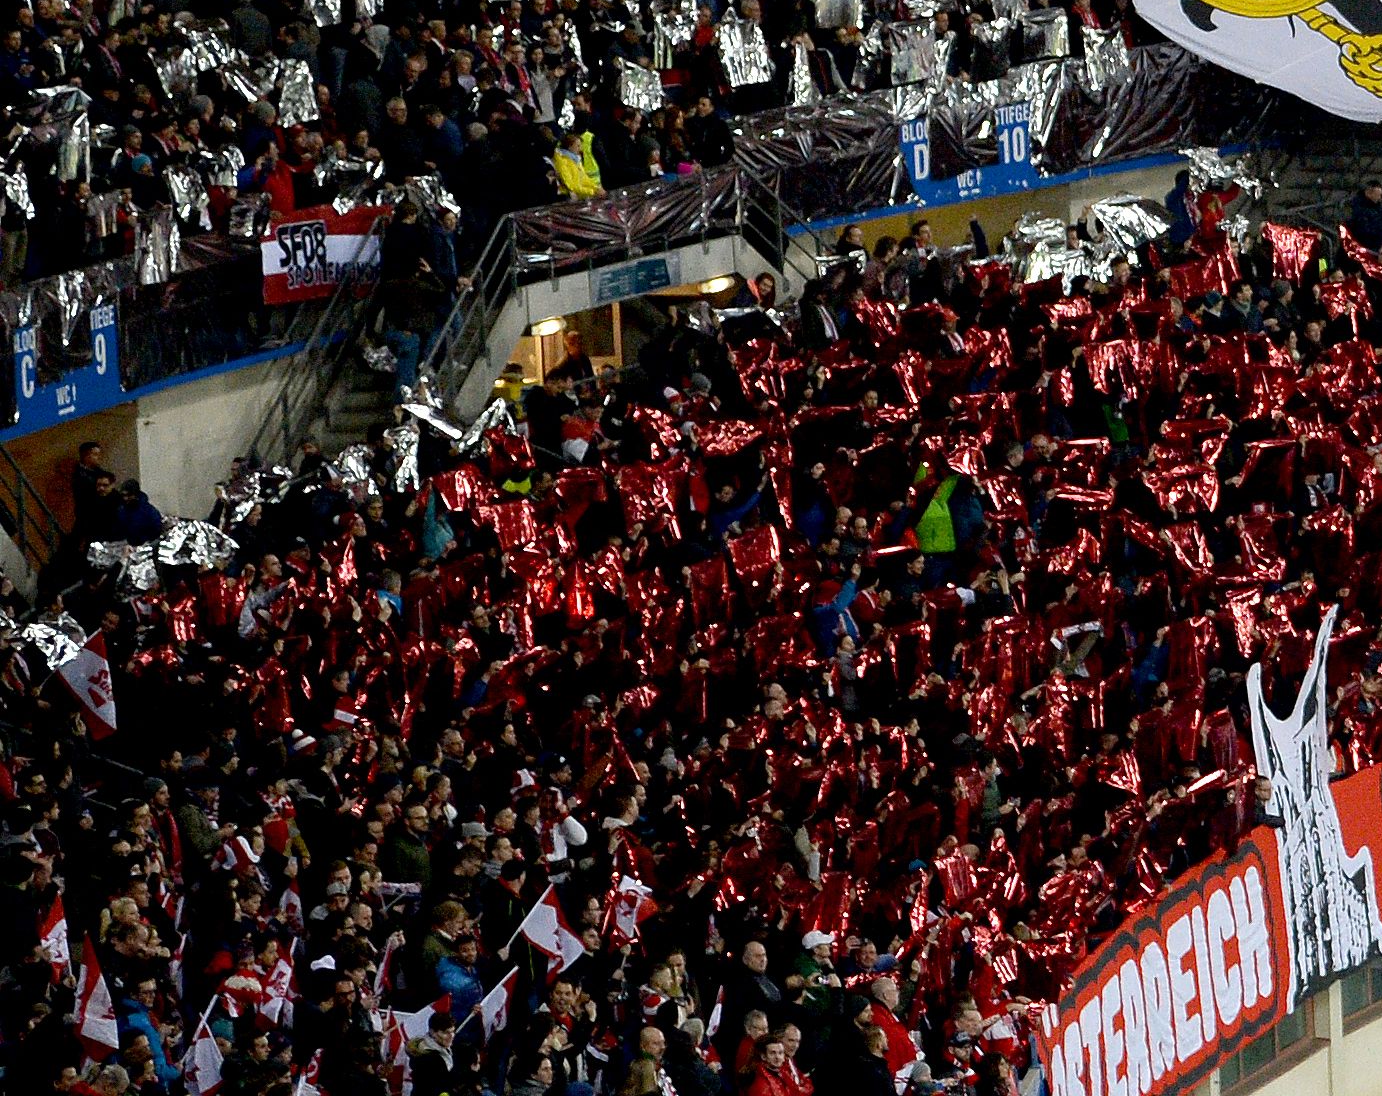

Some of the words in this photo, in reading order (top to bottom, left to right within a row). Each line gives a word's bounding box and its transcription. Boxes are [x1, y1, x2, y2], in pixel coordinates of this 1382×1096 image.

[914, 143, 930, 181] D
[999, 126, 1026, 164] 10
[94, 332, 107, 376] 9
[21, 354, 35, 399] C
